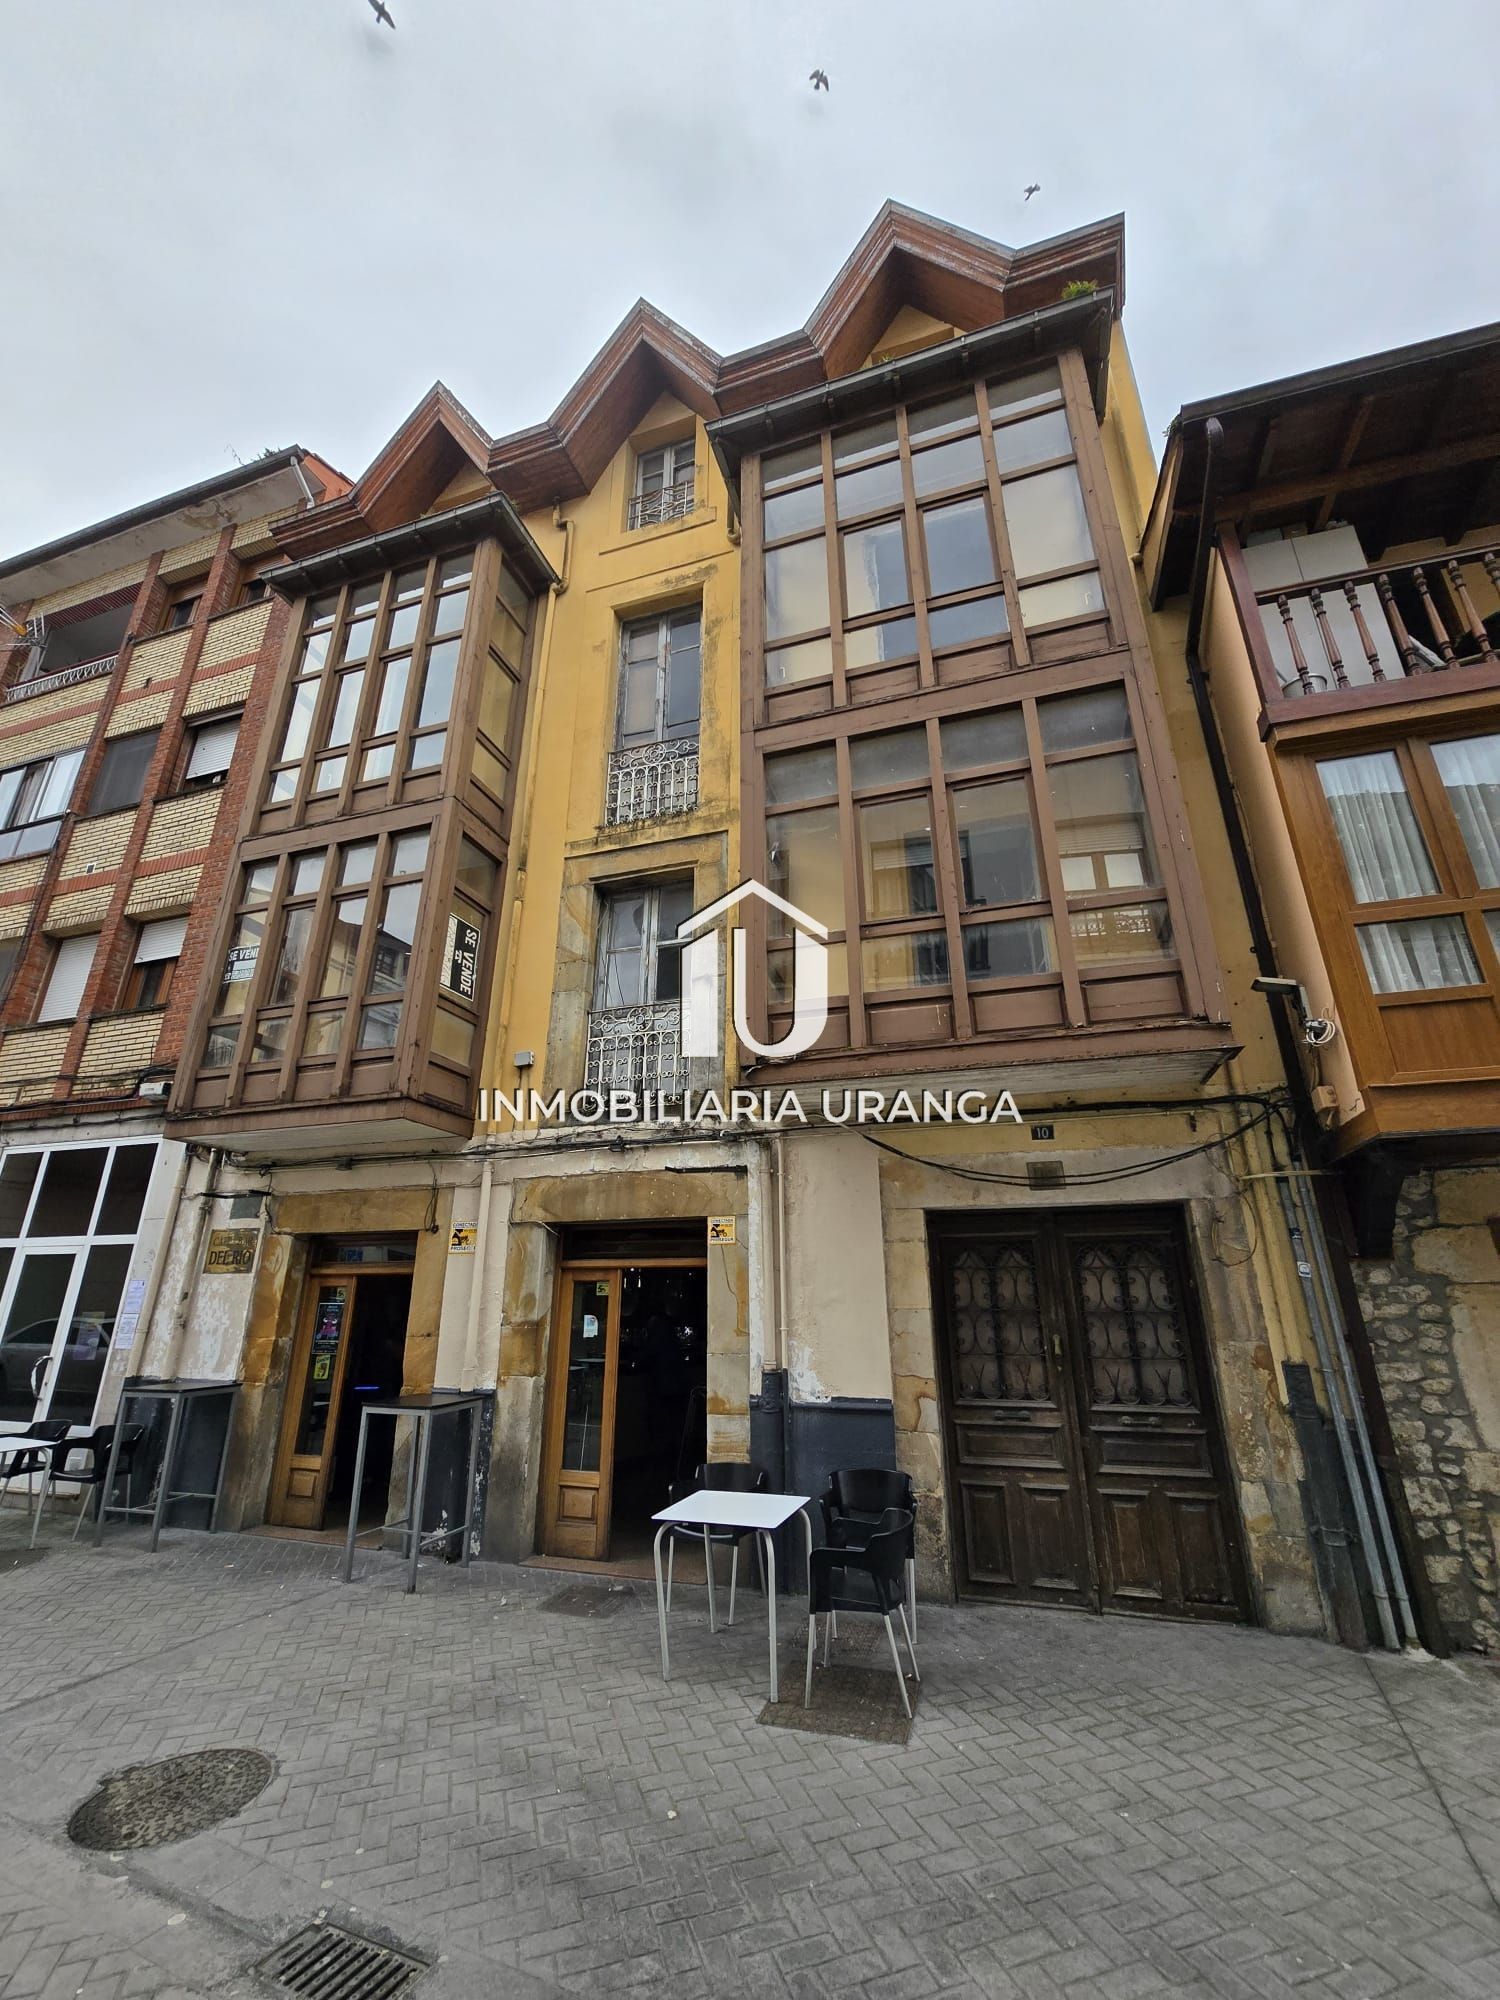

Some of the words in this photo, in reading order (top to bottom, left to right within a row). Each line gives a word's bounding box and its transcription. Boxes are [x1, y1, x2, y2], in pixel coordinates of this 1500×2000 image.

[465, 929, 477, 948] SE
[229, 950, 239, 961] SE
[240, 948, 260, 960] VEN
[460, 951, 474, 995] VENDE
[1036, 1127, 1049, 1139] 10
[208, 1250, 230, 1265] DEL
